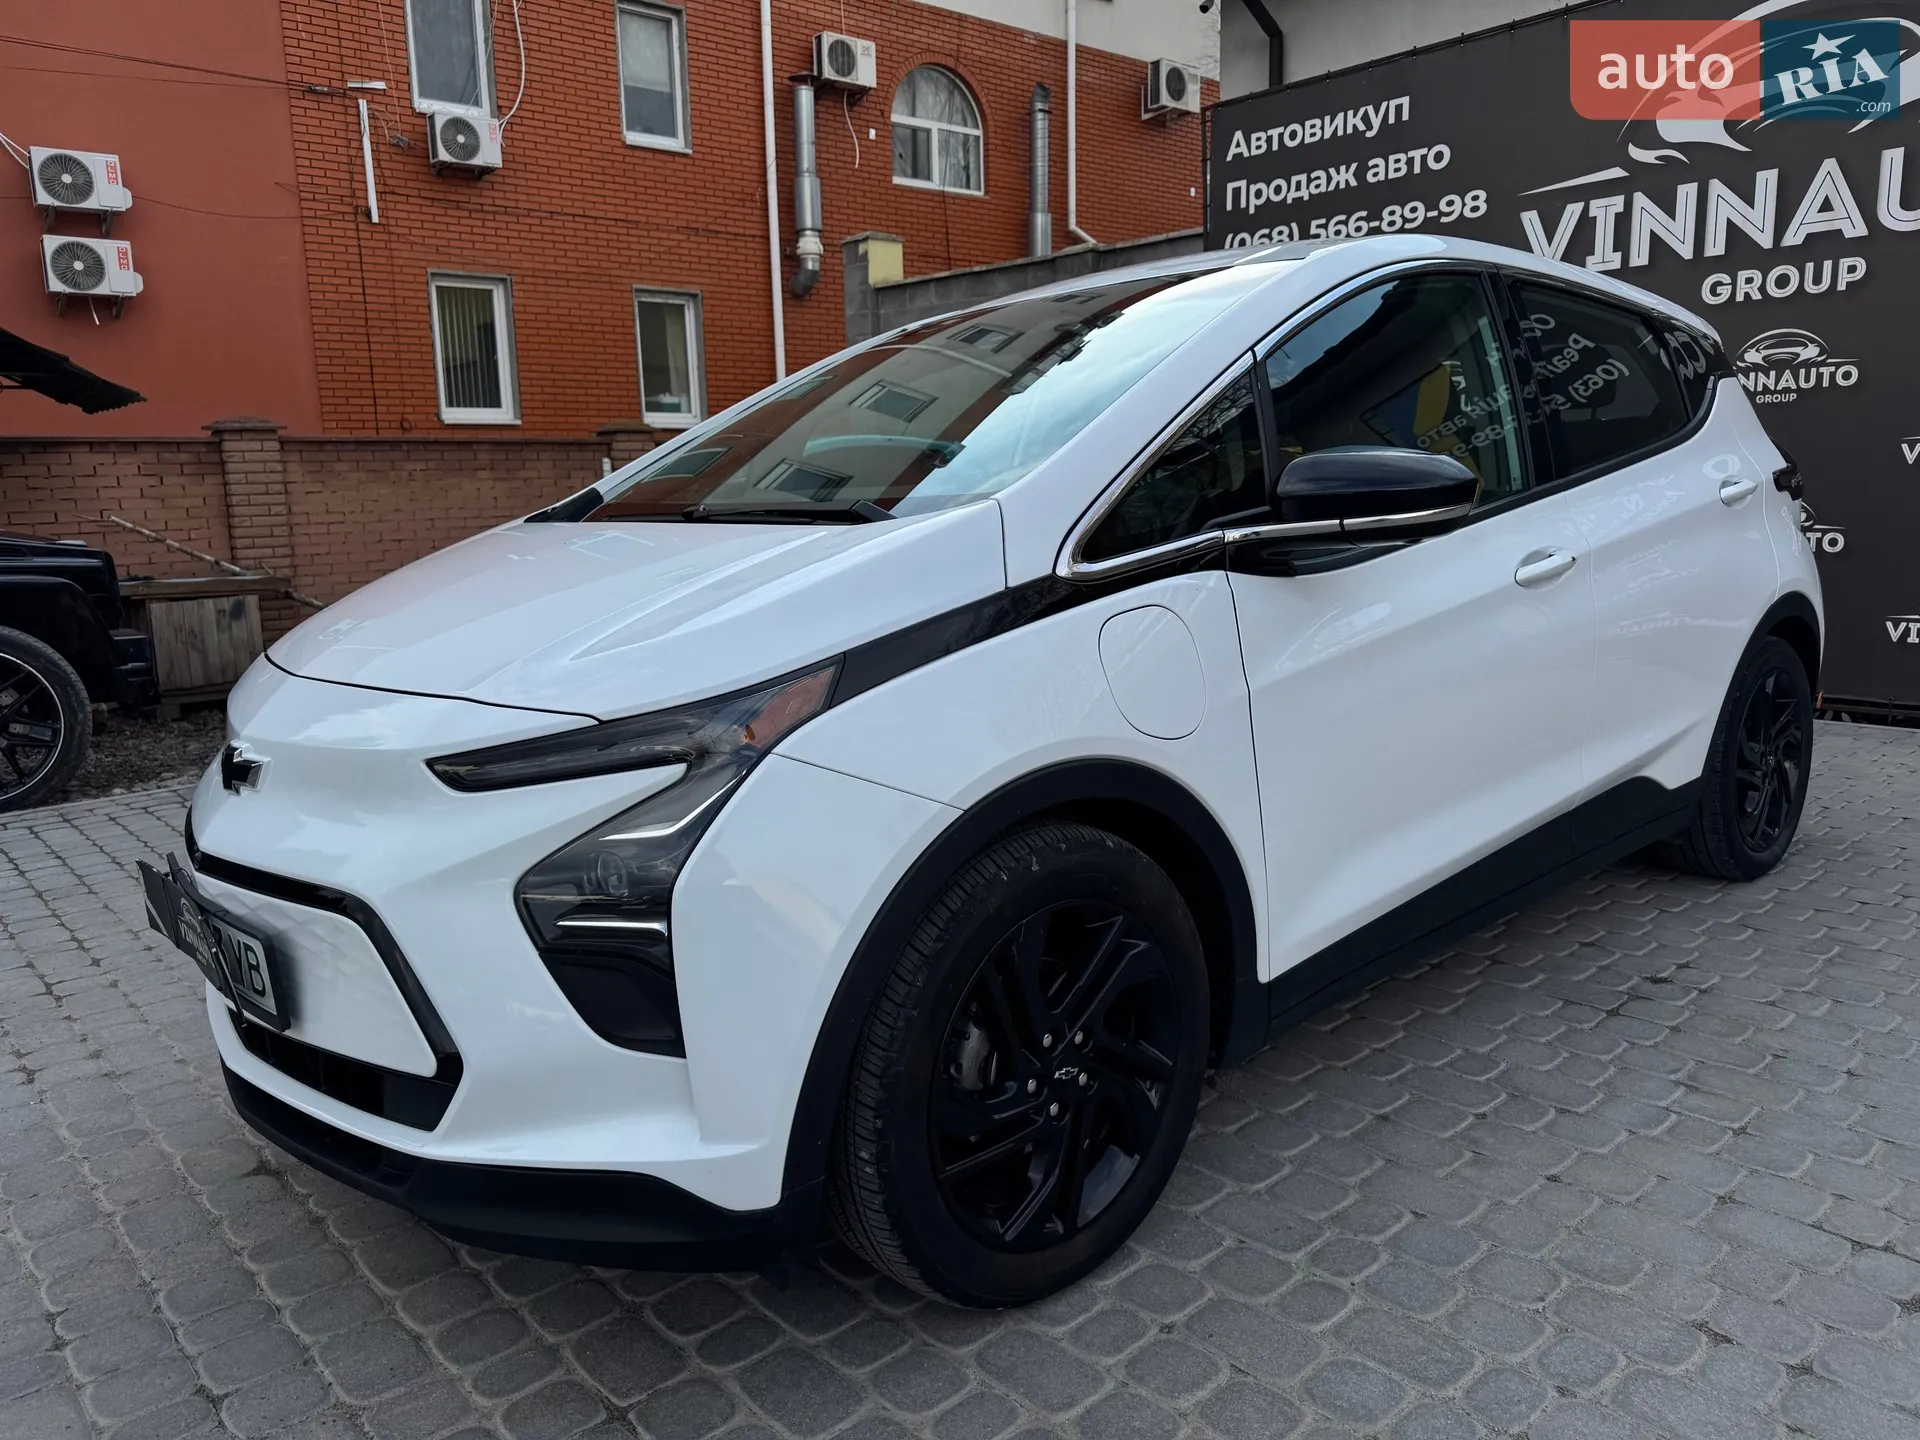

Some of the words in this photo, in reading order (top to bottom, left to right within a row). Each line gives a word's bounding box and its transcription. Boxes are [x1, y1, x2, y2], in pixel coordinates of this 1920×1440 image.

[1225, 95, 1411, 162] Автовикуп
[1225, 162, 1359, 214] Продаж
[1365, 144, 1452, 184] авто
[1308, 189, 1488, 240] 566-89-98
[1701, 257, 1867, 305] GROUP
[1755, 393, 1797, 404] GROUP
[1802, 532, 1845, 553] TO
